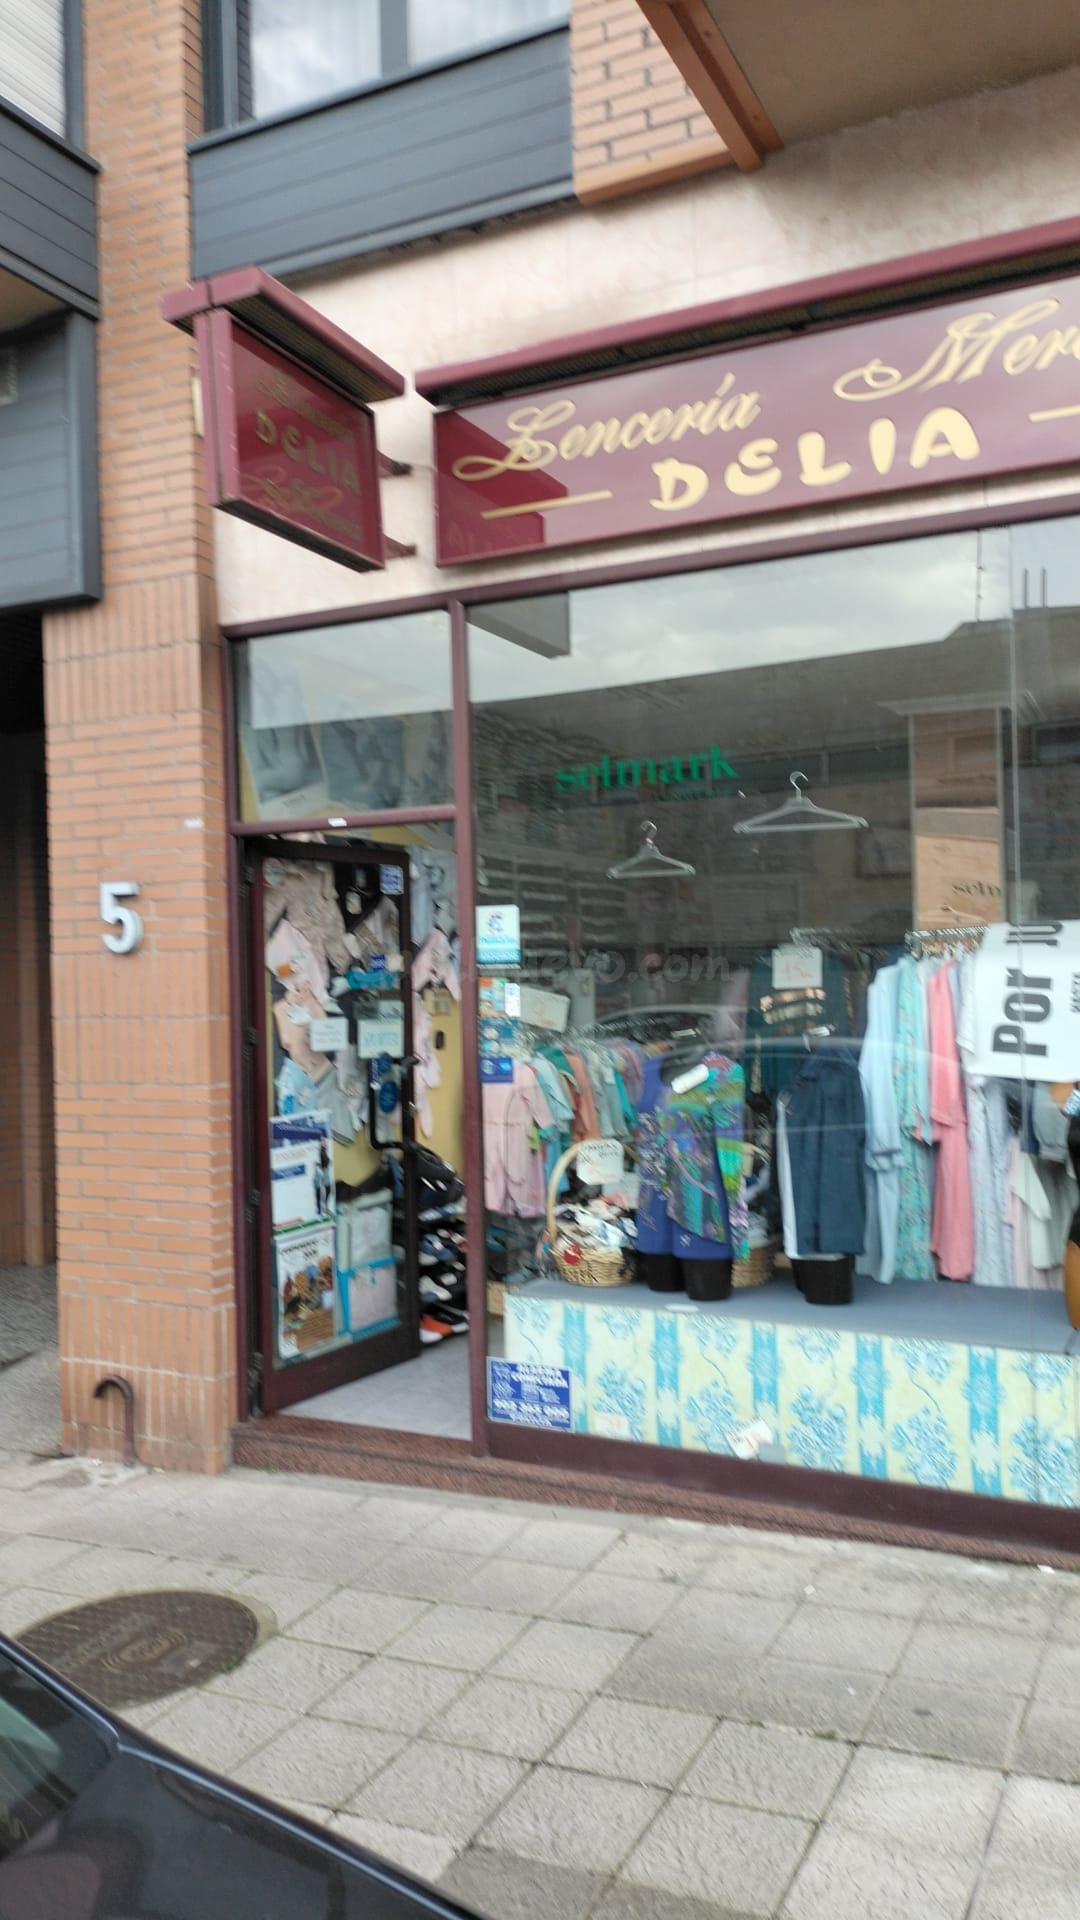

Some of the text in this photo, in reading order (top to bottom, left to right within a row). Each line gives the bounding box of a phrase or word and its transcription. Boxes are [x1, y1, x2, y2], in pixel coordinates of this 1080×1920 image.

[255, 408, 361, 496] DELIA
[452, 372, 761, 481] Lencería
[649, 407, 981, 511] DELIA
[100, 881, 144, 954] 5
